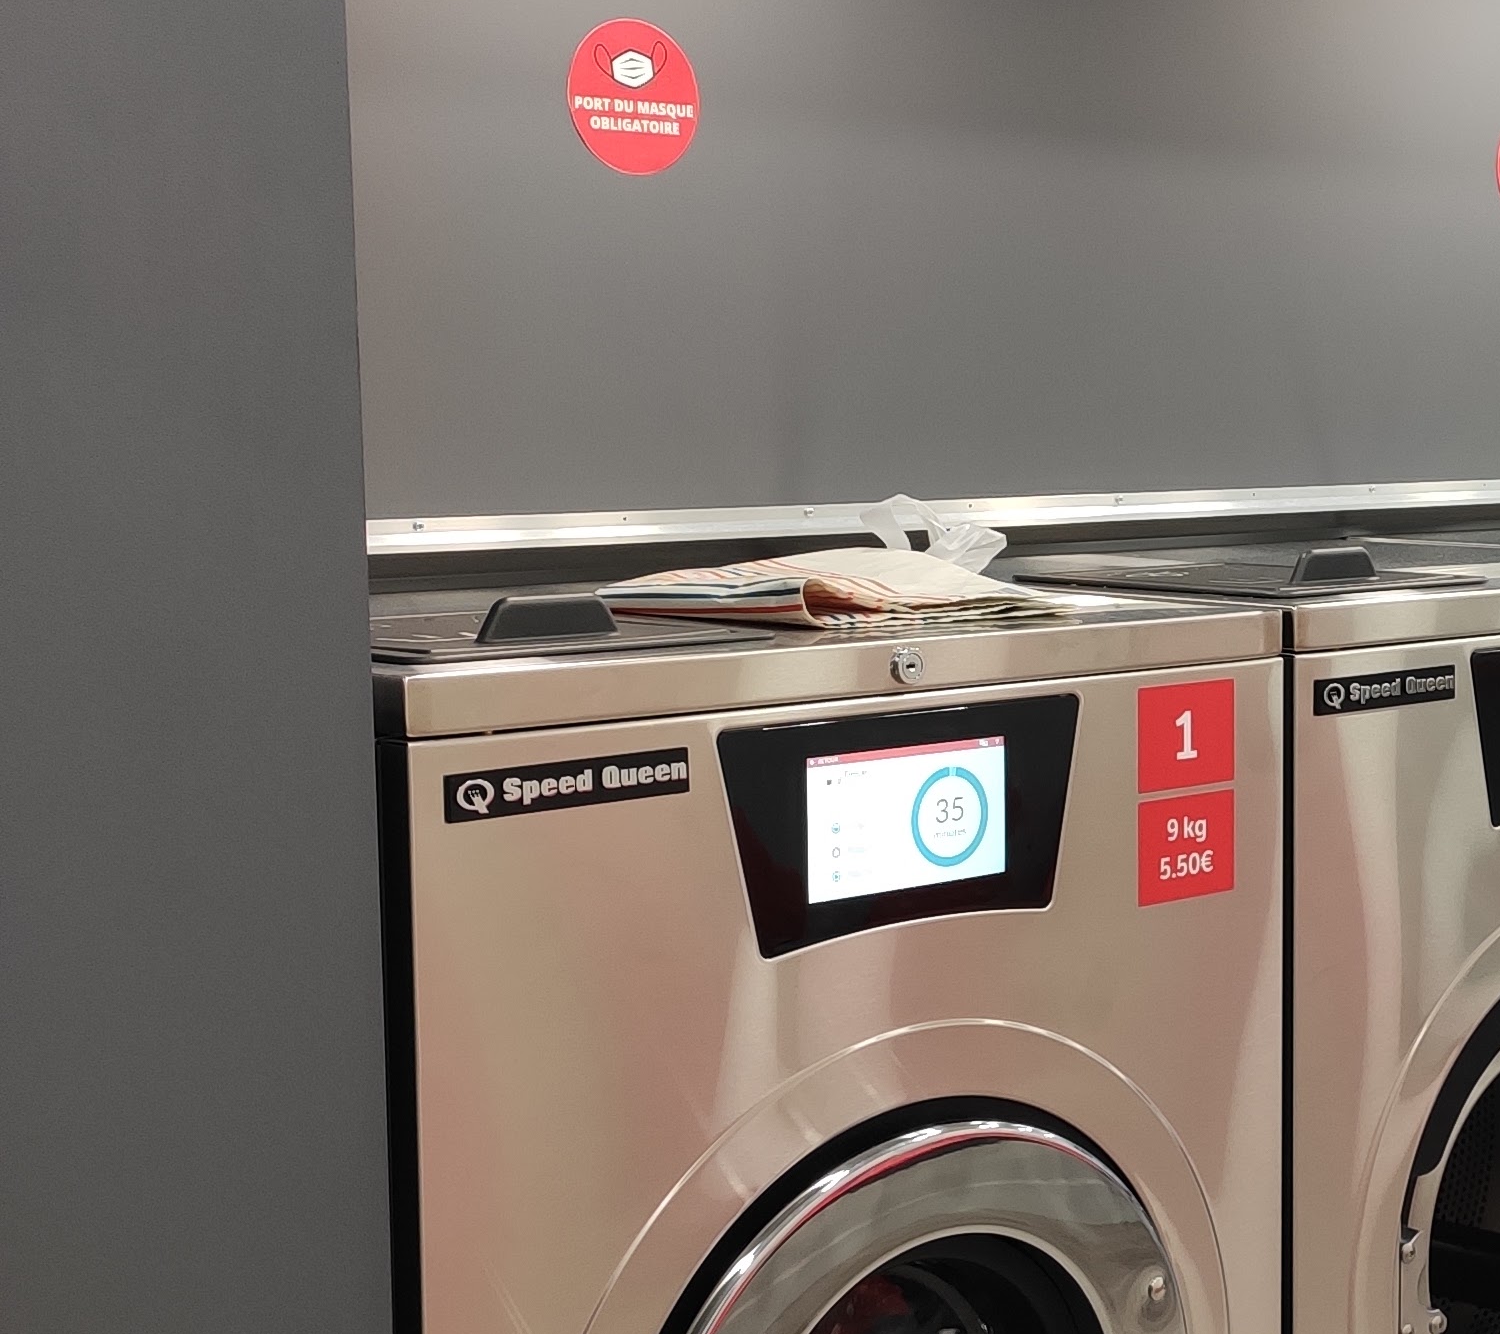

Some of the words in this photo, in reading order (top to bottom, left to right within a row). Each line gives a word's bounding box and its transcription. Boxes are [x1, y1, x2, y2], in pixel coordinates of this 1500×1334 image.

[574, 95, 611, 111] PORT
[614, 98, 633, 113] DU
[637, 100, 694, 119] MASQUE
[590, 116, 680, 136] OBLIGATOIRE
[1350, 677, 1400, 703] Speed
[1405, 672, 1455, 696] Queen
[1174, 711, 1198, 761] 1
[502, 767, 593, 806] Speed
[601, 756, 688, 792] Queen
[935, 796, 964, 823] 35
[1166, 816, 1180, 842] 9
[1182, 813, 1208, 845] kg
[1158, 849, 1215, 881] 5.50€
